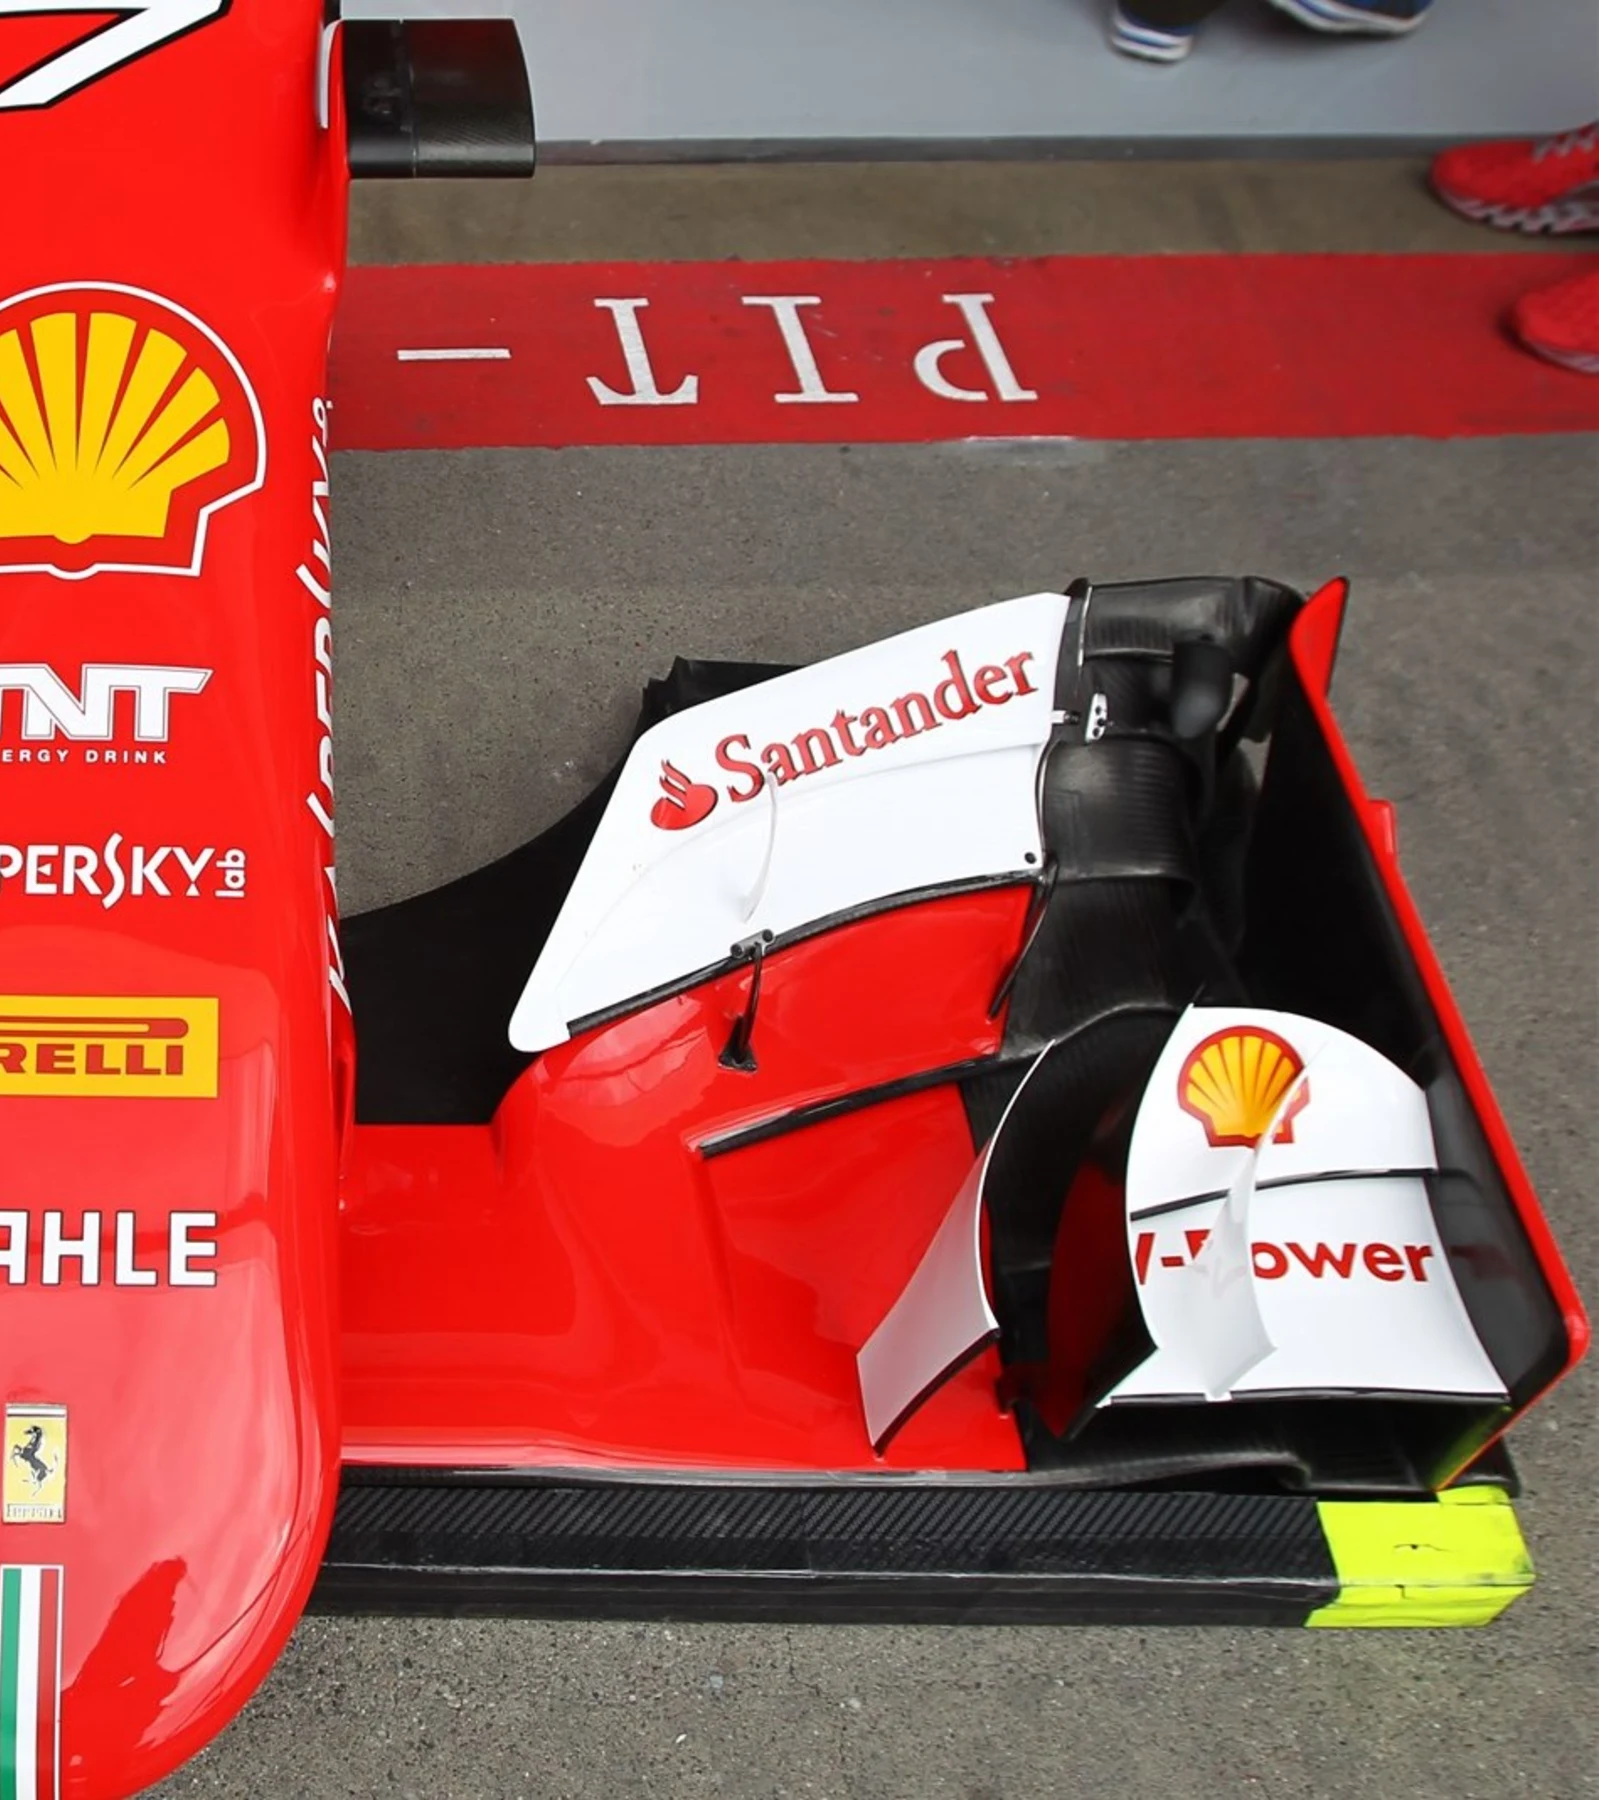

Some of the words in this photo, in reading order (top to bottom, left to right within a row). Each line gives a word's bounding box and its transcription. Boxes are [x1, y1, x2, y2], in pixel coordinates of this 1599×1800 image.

[715, 650, 1038, 804] Santander
[85, 749, 167, 764] DRINK
[215, 848, 246, 898] lab
